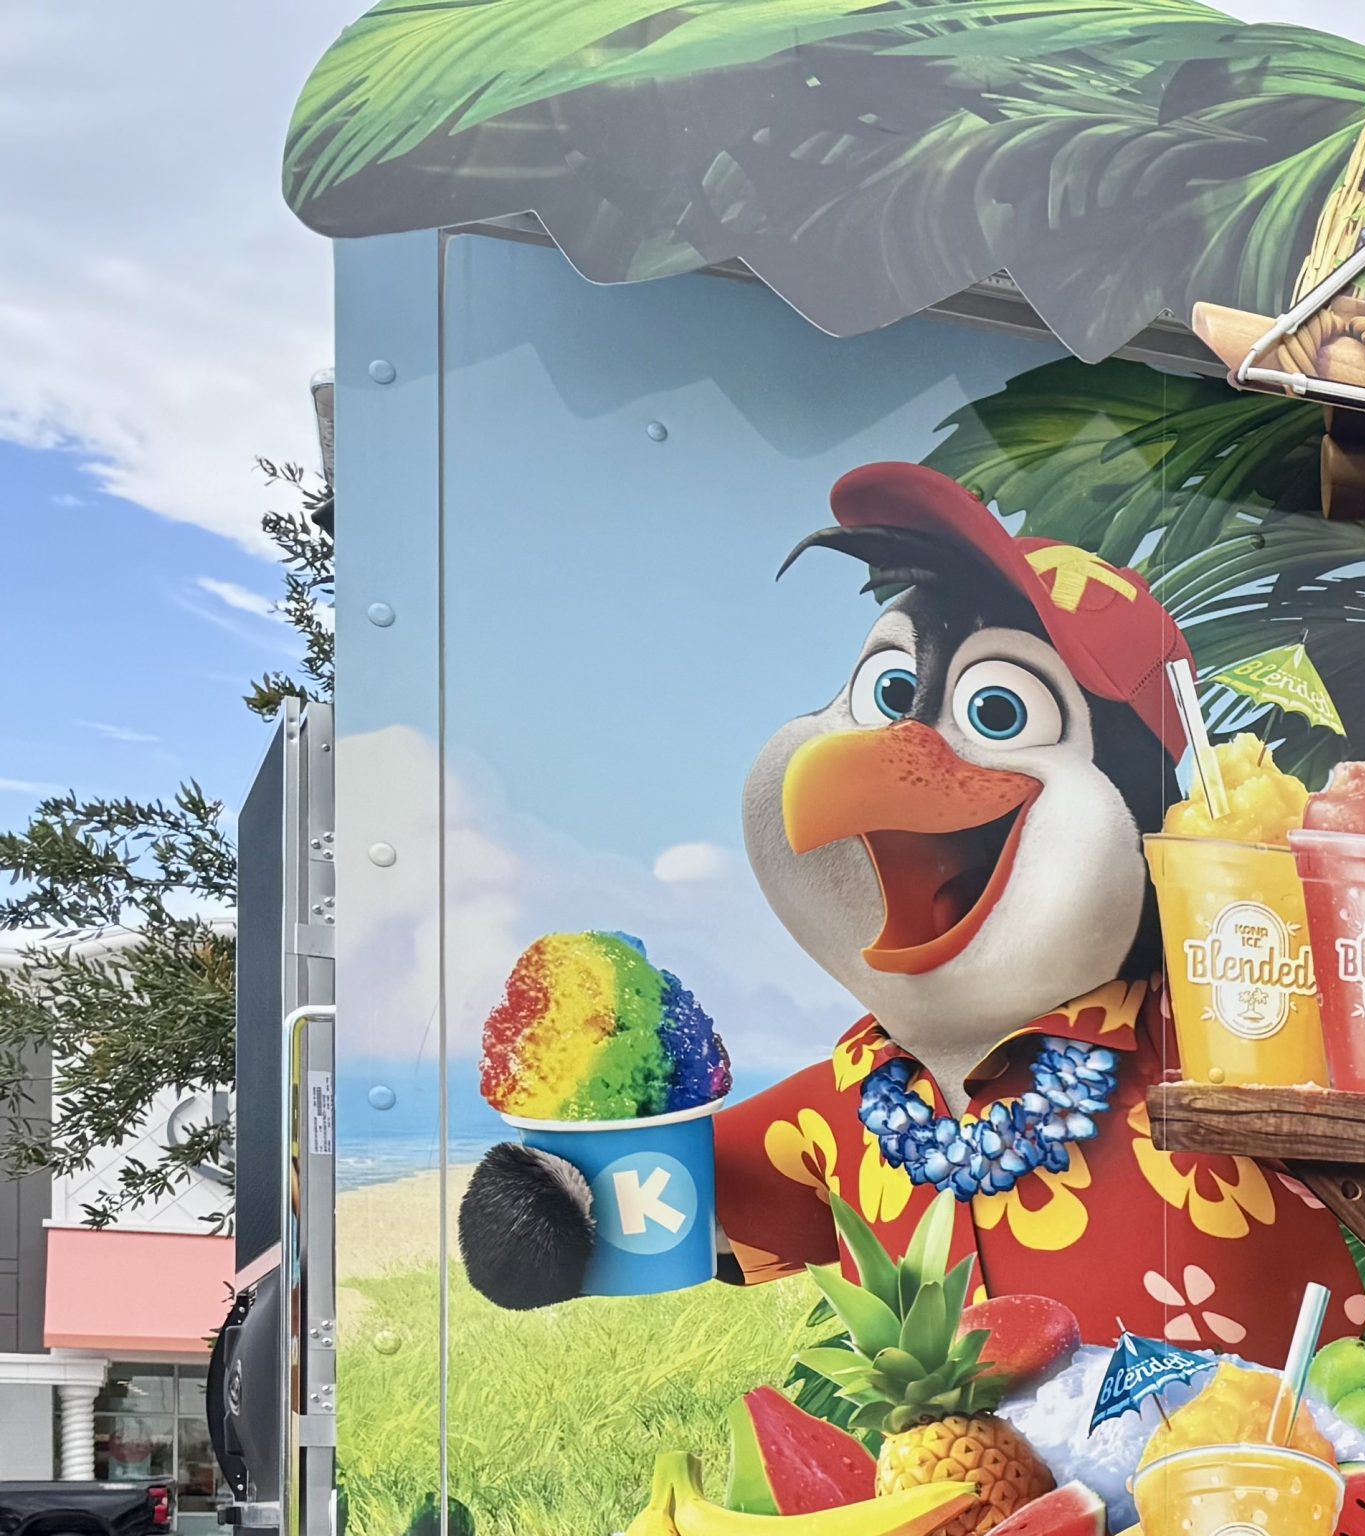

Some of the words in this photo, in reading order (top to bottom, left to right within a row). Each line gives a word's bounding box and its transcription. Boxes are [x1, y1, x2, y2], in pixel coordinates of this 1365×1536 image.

[1234, 922, 1268, 937] KONA
[1241, 935, 1262, 948] ICE
[1187, 938, 1317, 990] Blended
[612, 1166, 686, 1235] K
